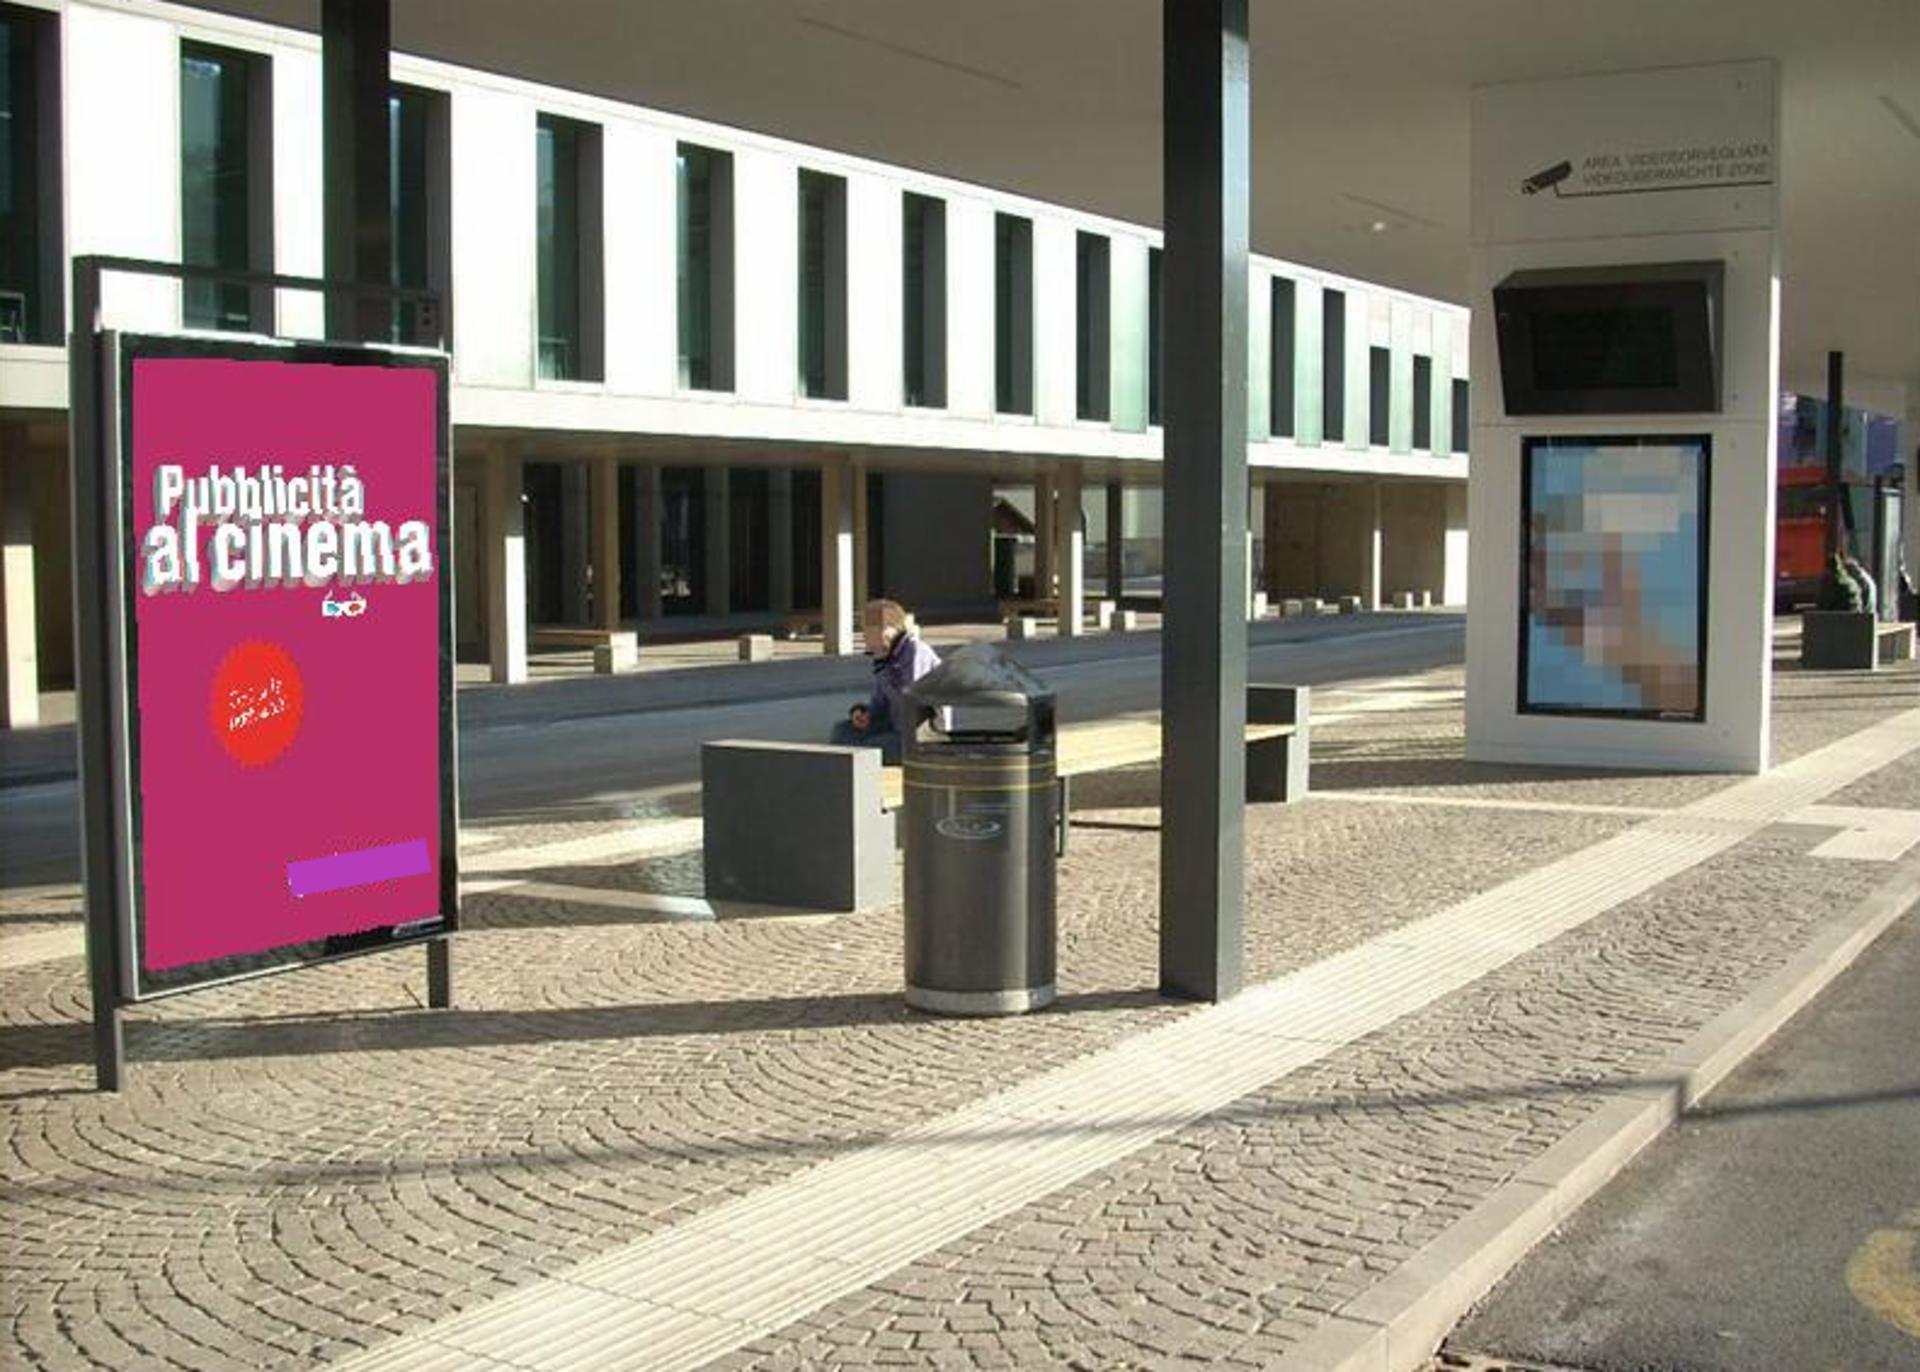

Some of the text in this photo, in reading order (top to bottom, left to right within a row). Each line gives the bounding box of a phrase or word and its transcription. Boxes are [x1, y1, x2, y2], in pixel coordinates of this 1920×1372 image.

[1582, 155, 1621, 170] AREA
[1727, 161, 1769, 178] ZONE
[145, 506, 433, 594] al cinema
